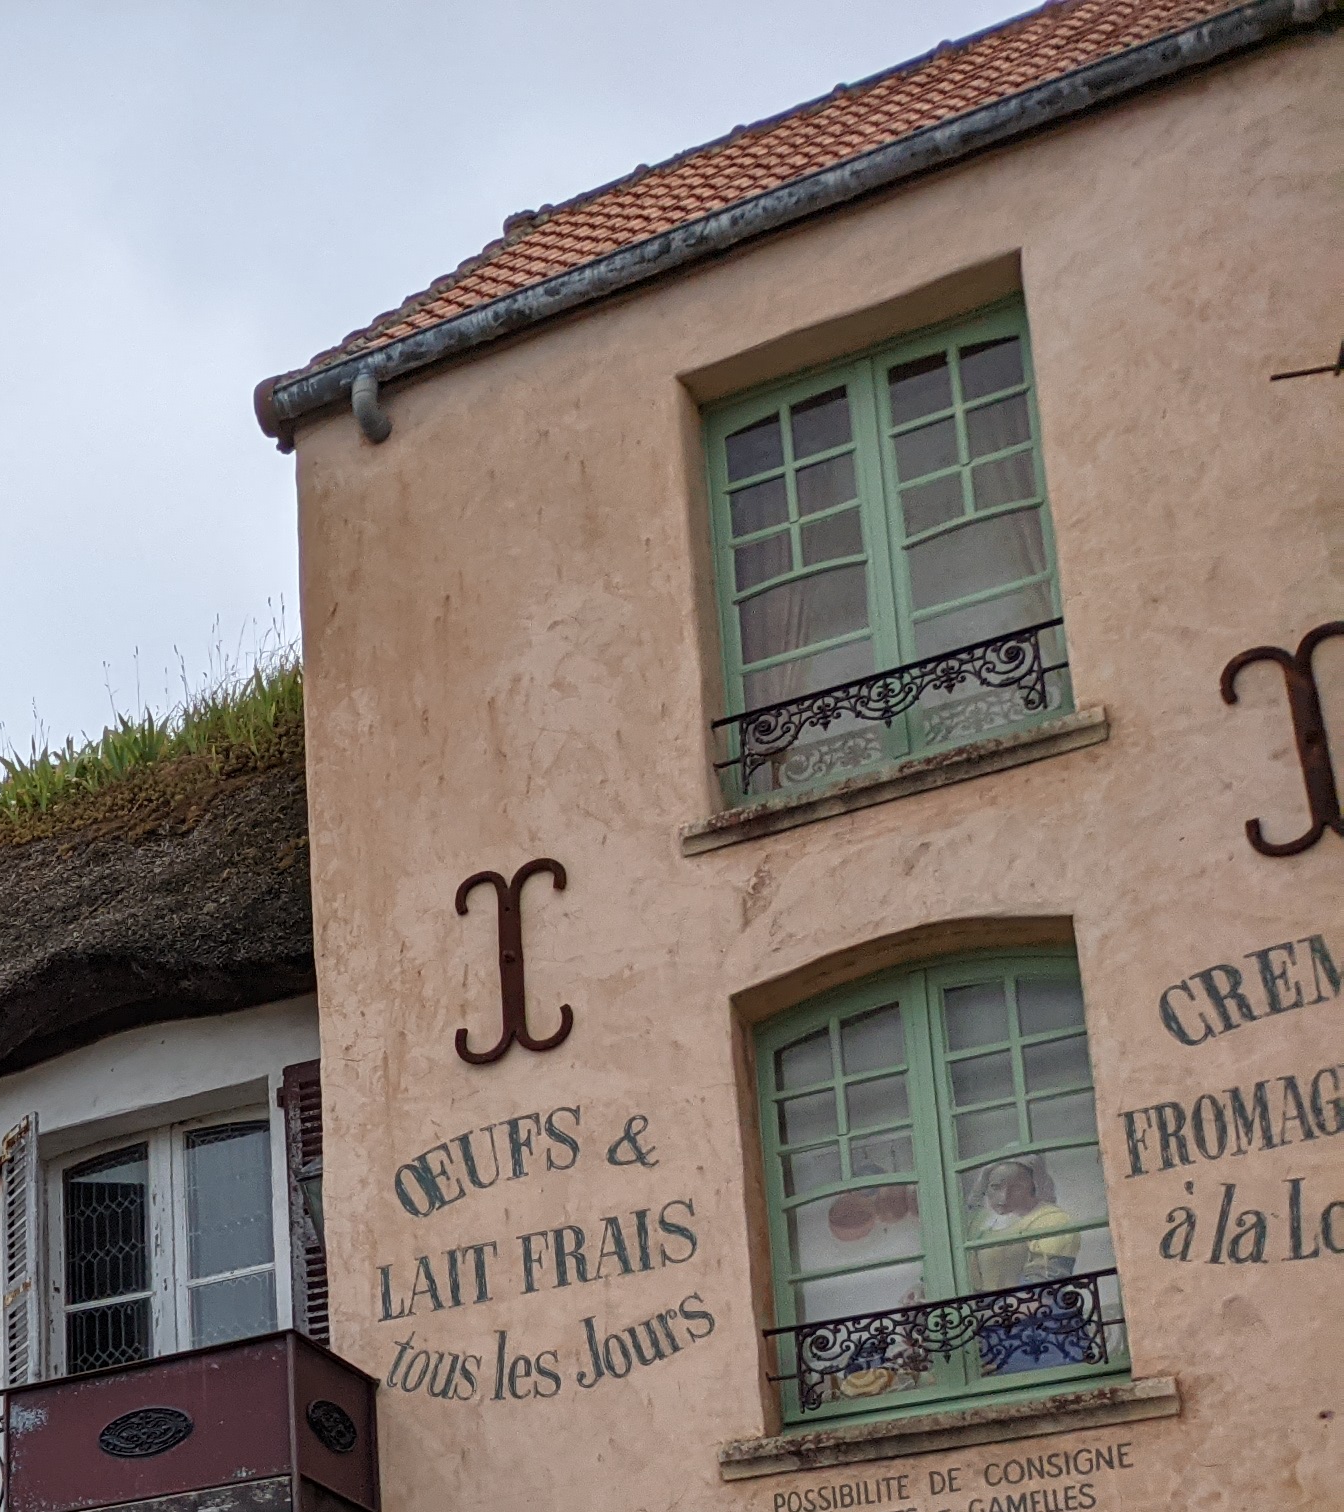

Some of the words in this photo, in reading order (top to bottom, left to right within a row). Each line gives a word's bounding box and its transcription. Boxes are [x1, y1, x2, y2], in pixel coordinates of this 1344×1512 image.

[605, 1114, 660, 1168] &
[376, 1240, 498, 1323] LAIT
[516, 1197, 699, 1295] FRAIS
[1159, 1180, 1197, 1263] à
[1204, 1183, 1267, 1264] la
[385, 1330, 482, 1401] tous
[489, 1329, 562, 1402] les
[575, 1291, 716, 1389] Jours
[928, 1467, 962, 1496] DE
[983, 1442, 1135, 1487] CONSIGNE
